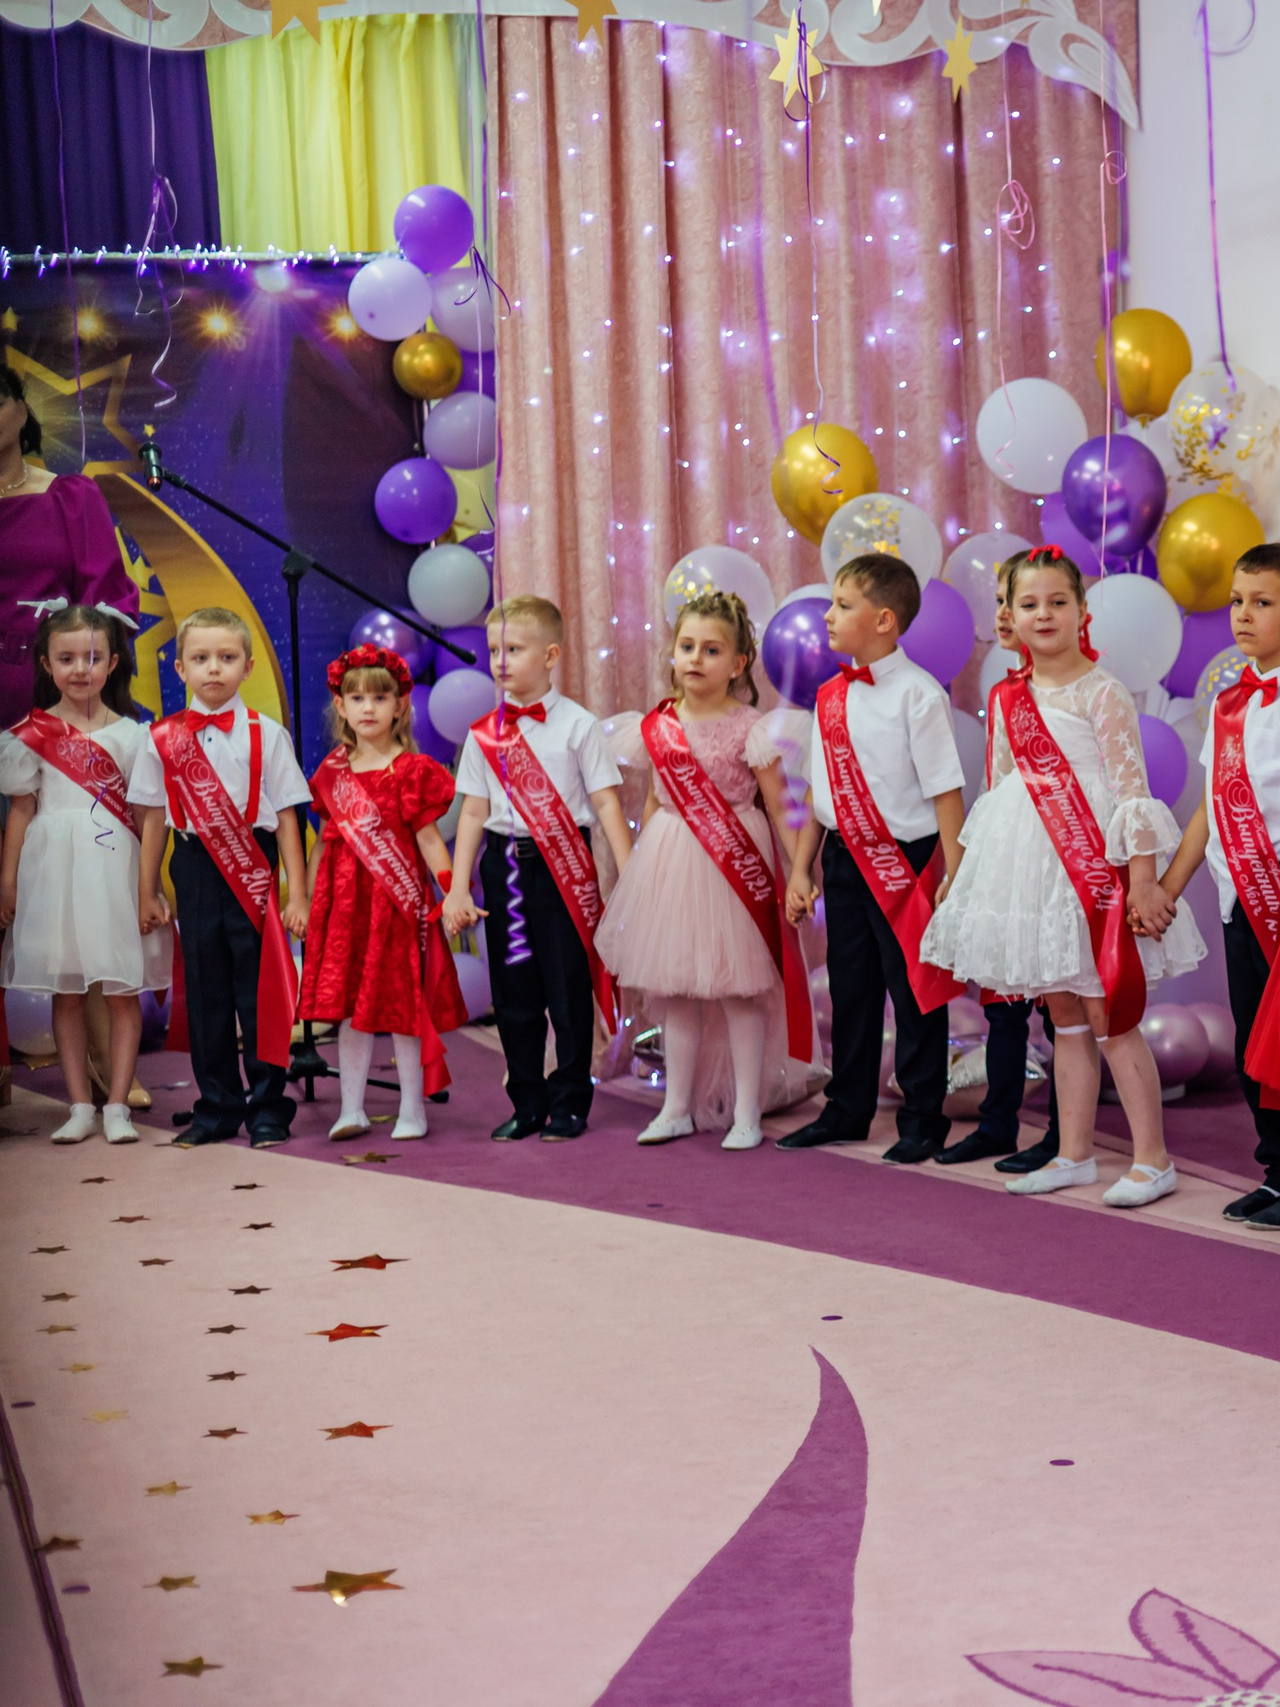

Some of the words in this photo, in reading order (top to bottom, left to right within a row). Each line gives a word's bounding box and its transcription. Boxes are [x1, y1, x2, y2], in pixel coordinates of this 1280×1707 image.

[863, 843, 911, 893] 2024
[1226, 778, 1280, 915] Выпускник
[239, 868, 270, 914] 202
[731, 853, 772, 902] 2024
[1077, 857, 1120, 911] 2024
